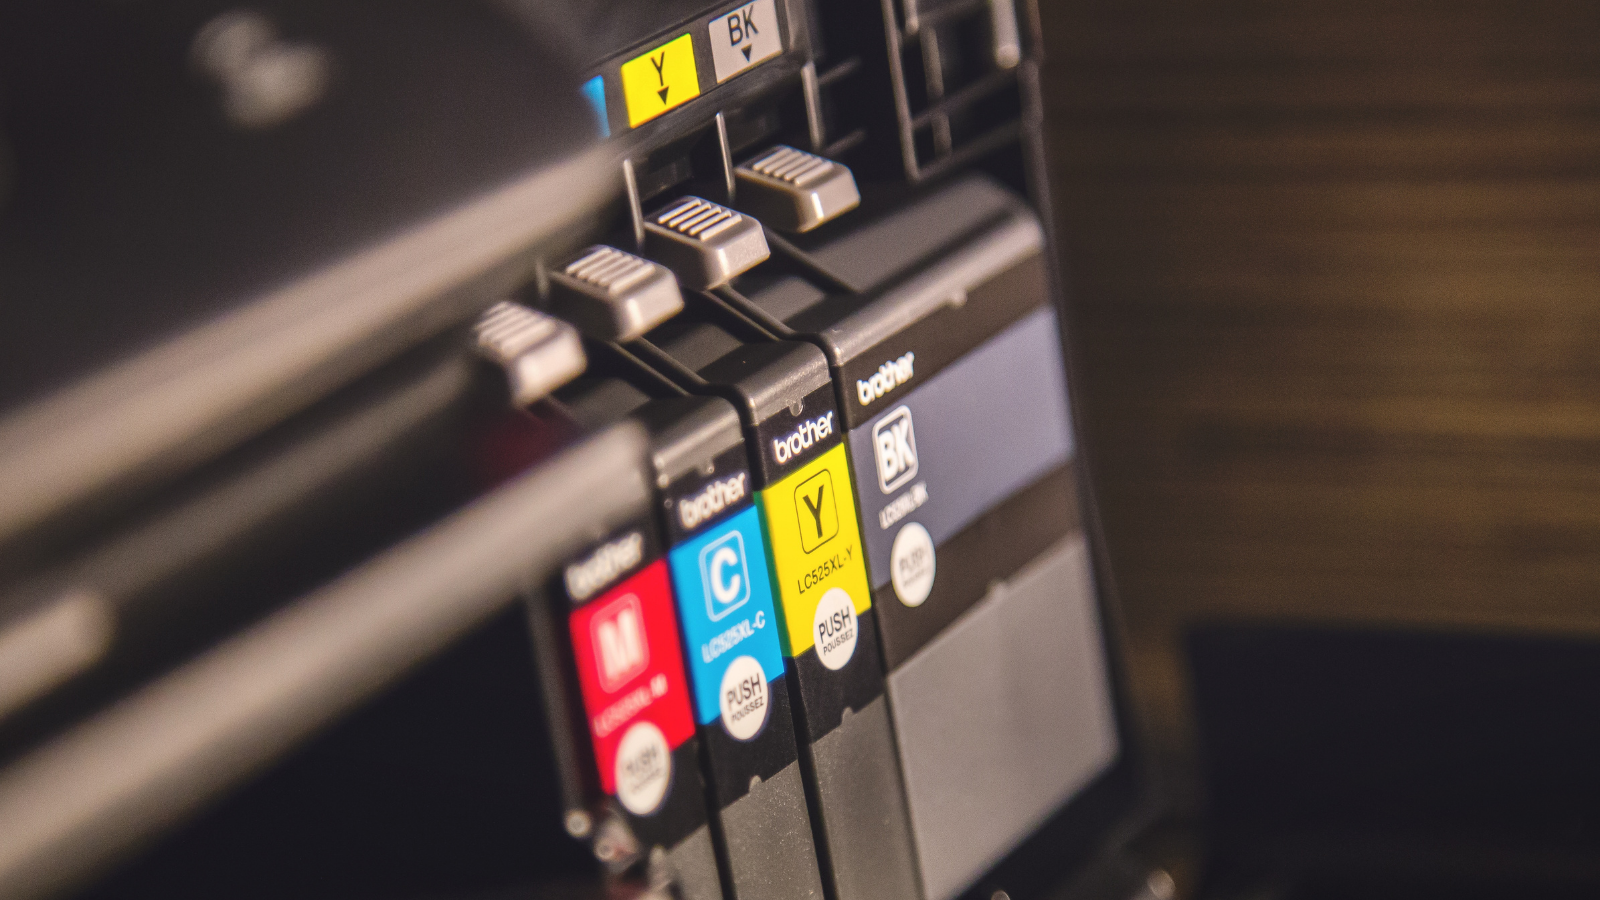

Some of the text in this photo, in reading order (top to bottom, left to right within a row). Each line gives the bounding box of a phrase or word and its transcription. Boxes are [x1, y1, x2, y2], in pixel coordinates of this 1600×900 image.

[727, 5, 759, 46] BK
[650, 51, 665, 86] Y
[856, 351, 915, 406] brother
[773, 410, 834, 463] brother
[878, 418, 914, 482] BK
[680, 472, 746, 529] brother
[802, 484, 825, 539] Y
[710, 547, 741, 604] C
[797, 544, 853, 595] LC525XL-Y
[598, 608, 645, 682] M
[819, 605, 852, 644] PUSH
[823, 628, 855, 656] POUSSEZ
[726, 673, 762, 713] PUSH
